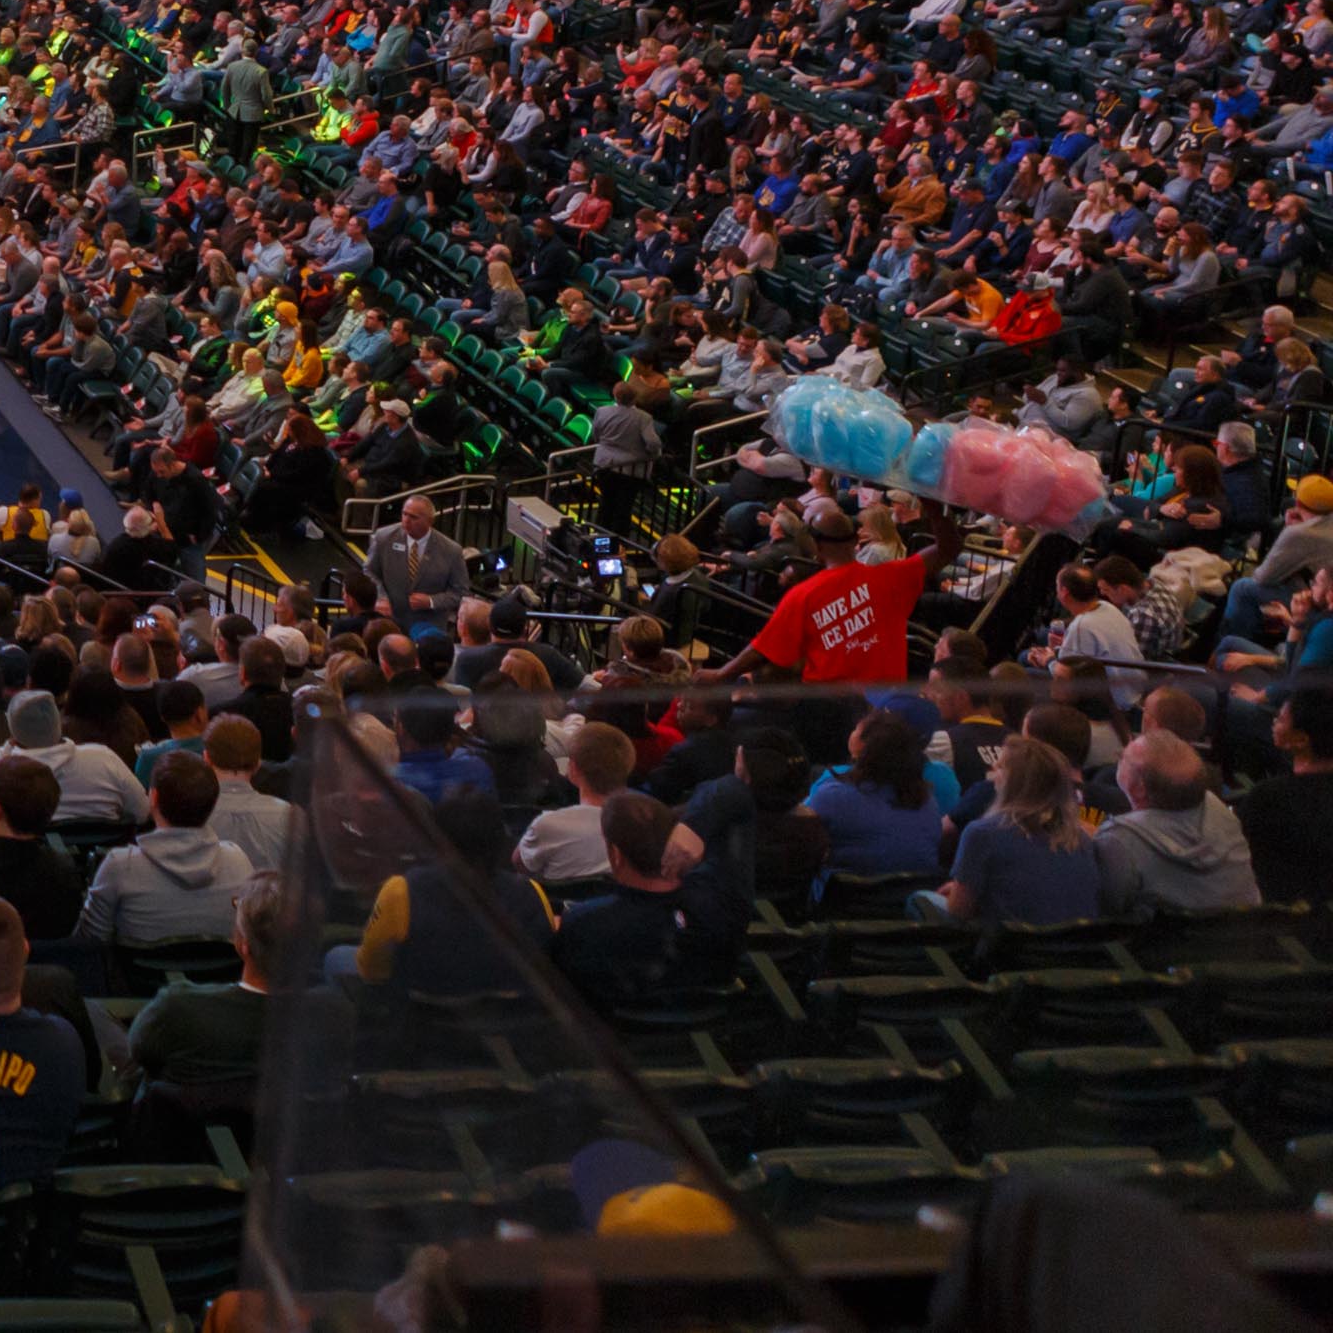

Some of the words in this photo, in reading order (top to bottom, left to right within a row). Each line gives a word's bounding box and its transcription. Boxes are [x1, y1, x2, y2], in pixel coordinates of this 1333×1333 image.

[812, 596, 848, 630] HAVE
[850, 582, 871, 610] AN
[821, 625, 844, 651] ICE
[844, 606, 876, 637] DAY!
